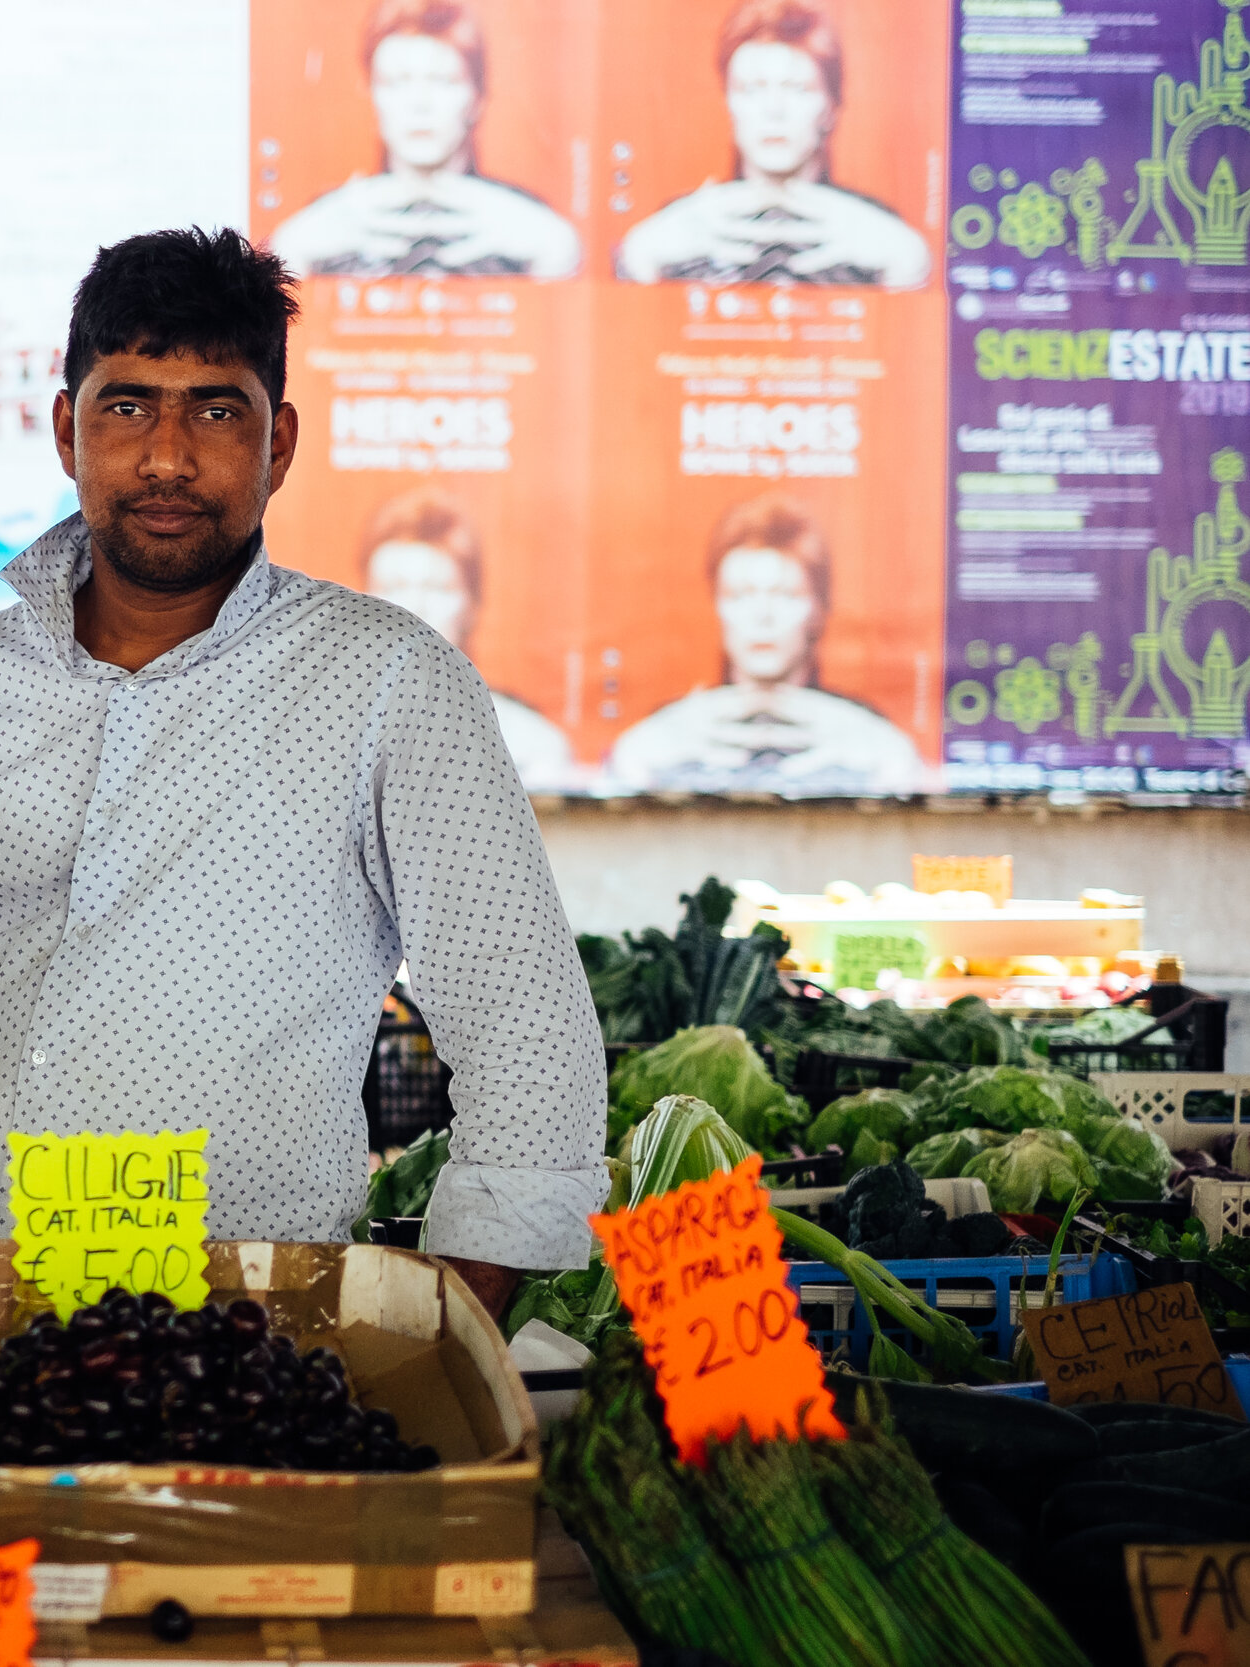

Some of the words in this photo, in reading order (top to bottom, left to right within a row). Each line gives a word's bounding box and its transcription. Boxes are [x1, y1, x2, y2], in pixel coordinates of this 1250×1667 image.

[331, 397, 513, 445] HEROES
[681, 402, 861, 451] HEROES
[19, 1144, 209, 1201] CILIGIE
[27, 1207, 80, 1237] CAT.
